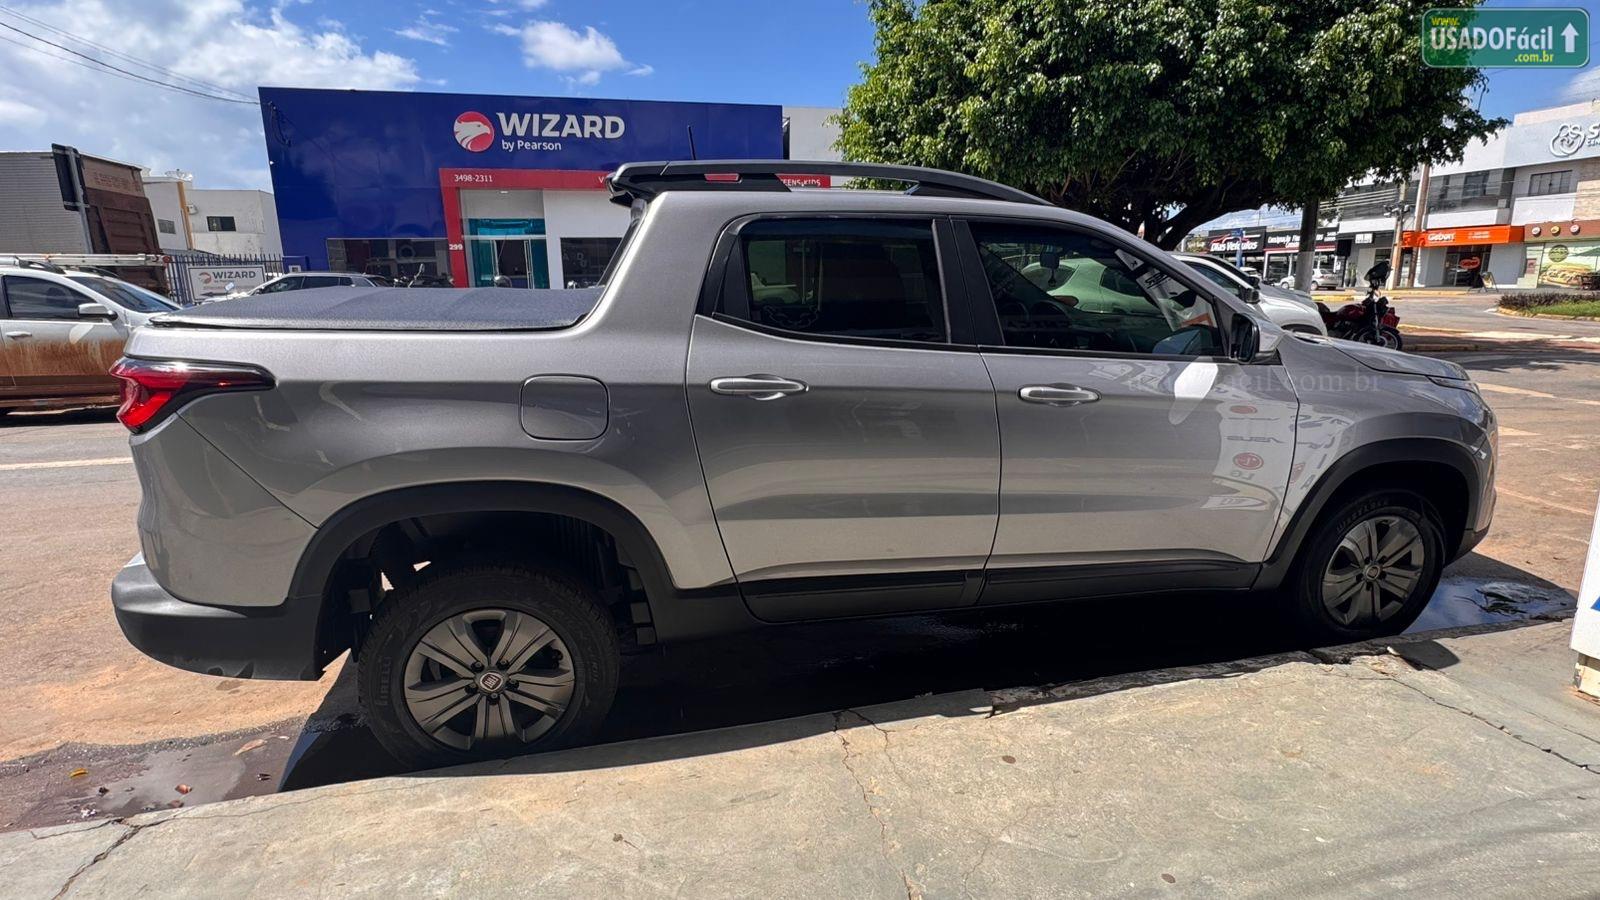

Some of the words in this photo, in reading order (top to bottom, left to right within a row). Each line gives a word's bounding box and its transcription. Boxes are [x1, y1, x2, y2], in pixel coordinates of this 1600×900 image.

[496, 112, 625, 139] WIZARD
[502, 139, 514, 152] by
[517, 140, 562, 151] Pearson
[454, 174, 493, 182] 3498-2311
[212, 271, 256, 279] WIZARD
